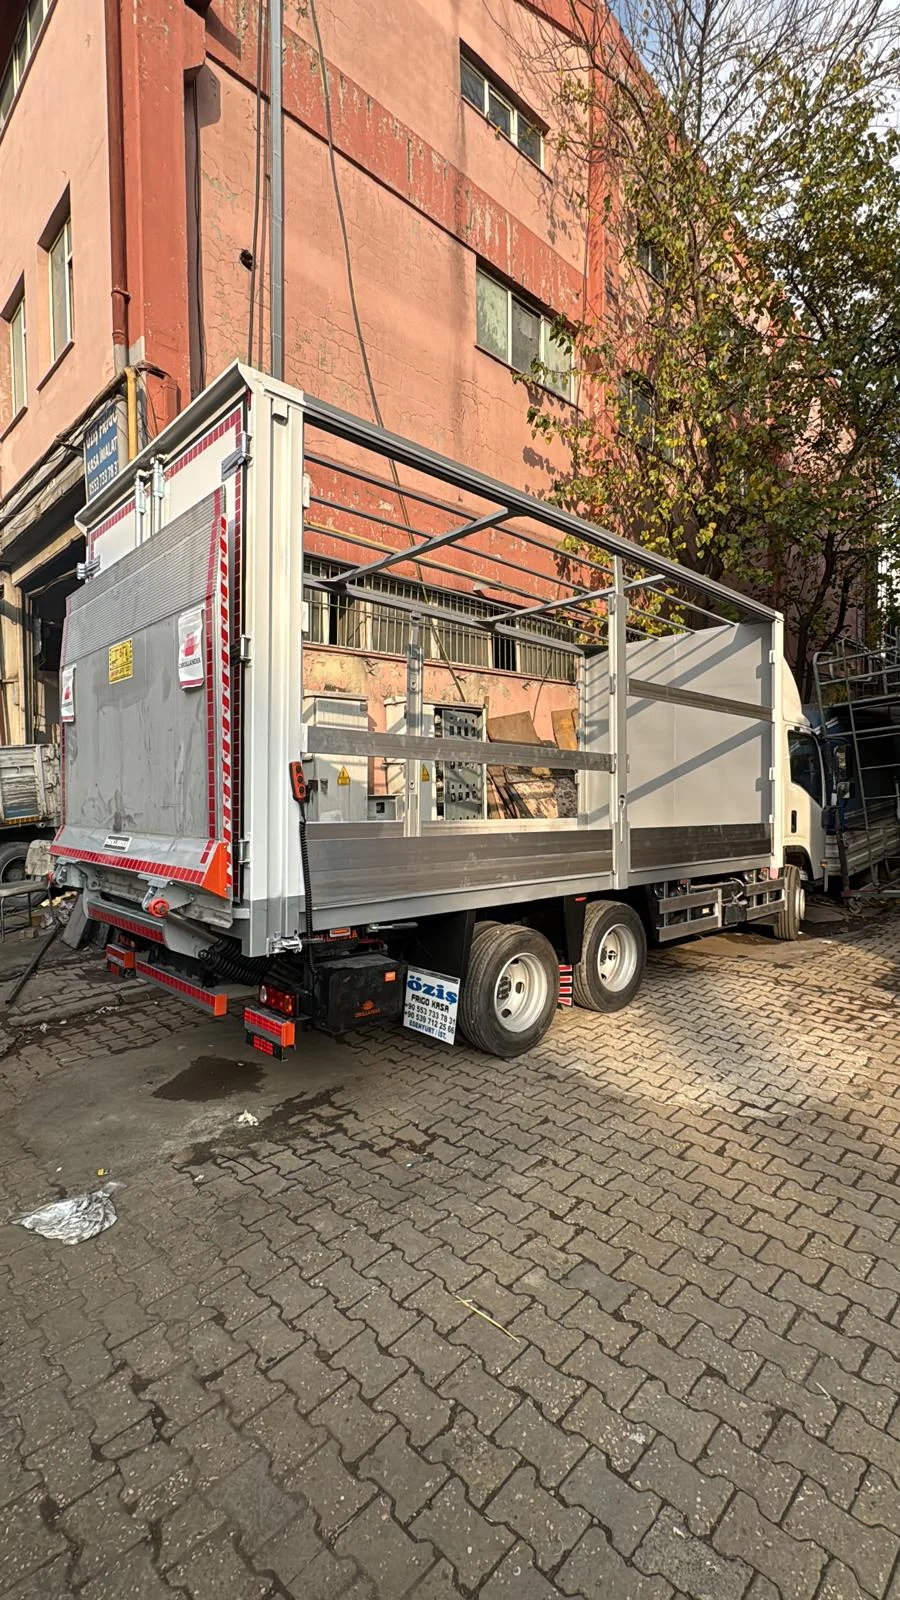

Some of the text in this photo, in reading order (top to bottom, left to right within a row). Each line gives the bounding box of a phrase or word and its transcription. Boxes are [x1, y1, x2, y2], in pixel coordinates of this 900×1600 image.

[405, 1003, 415, 1011] +90
[416, 1006, 427, 1015] 553
[428, 1010, 439, 1019] 733
[440, 1014, 448, 1022] 78
[431, 1000, 449, 1013] KASA
[404, 1011, 415, 1019] +90
[416, 1014, 427, 1023] 539
[428, 1018, 438, 1028] 712
[439, 1022, 447, 1031] 25
[409, 1020, 435, 1035] ESENYURT
